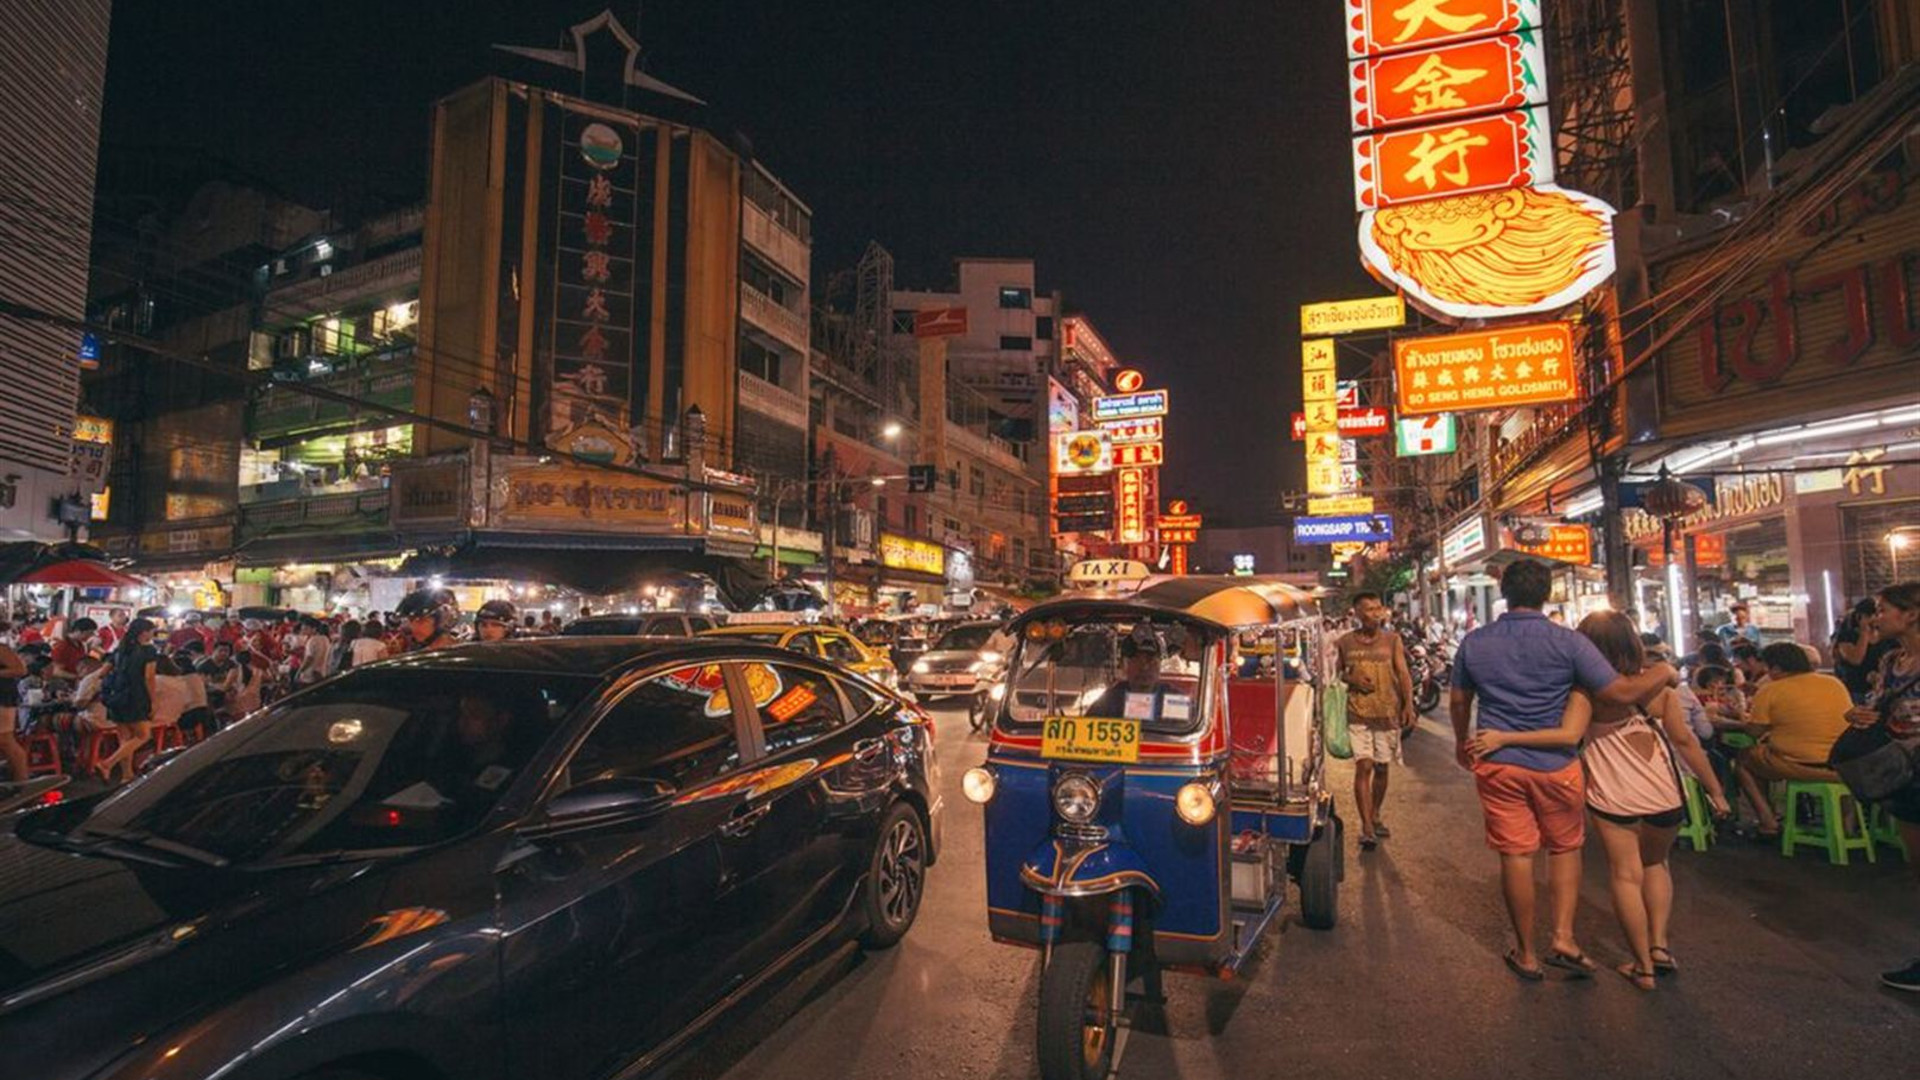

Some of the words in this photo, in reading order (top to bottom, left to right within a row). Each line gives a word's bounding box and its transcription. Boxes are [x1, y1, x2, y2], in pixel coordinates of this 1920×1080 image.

[1409, 393, 1424, 405] SO
[1428, 390, 1459, 403] SENG
[1463, 386, 1495, 400] HENG
[1498, 379, 1568, 397] GOLDSMITH
[1297, 522, 1353, 537] ROONGSARP
[1082, 562, 1130, 576] TAXI
[1086, 721, 1135, 744] 1553
